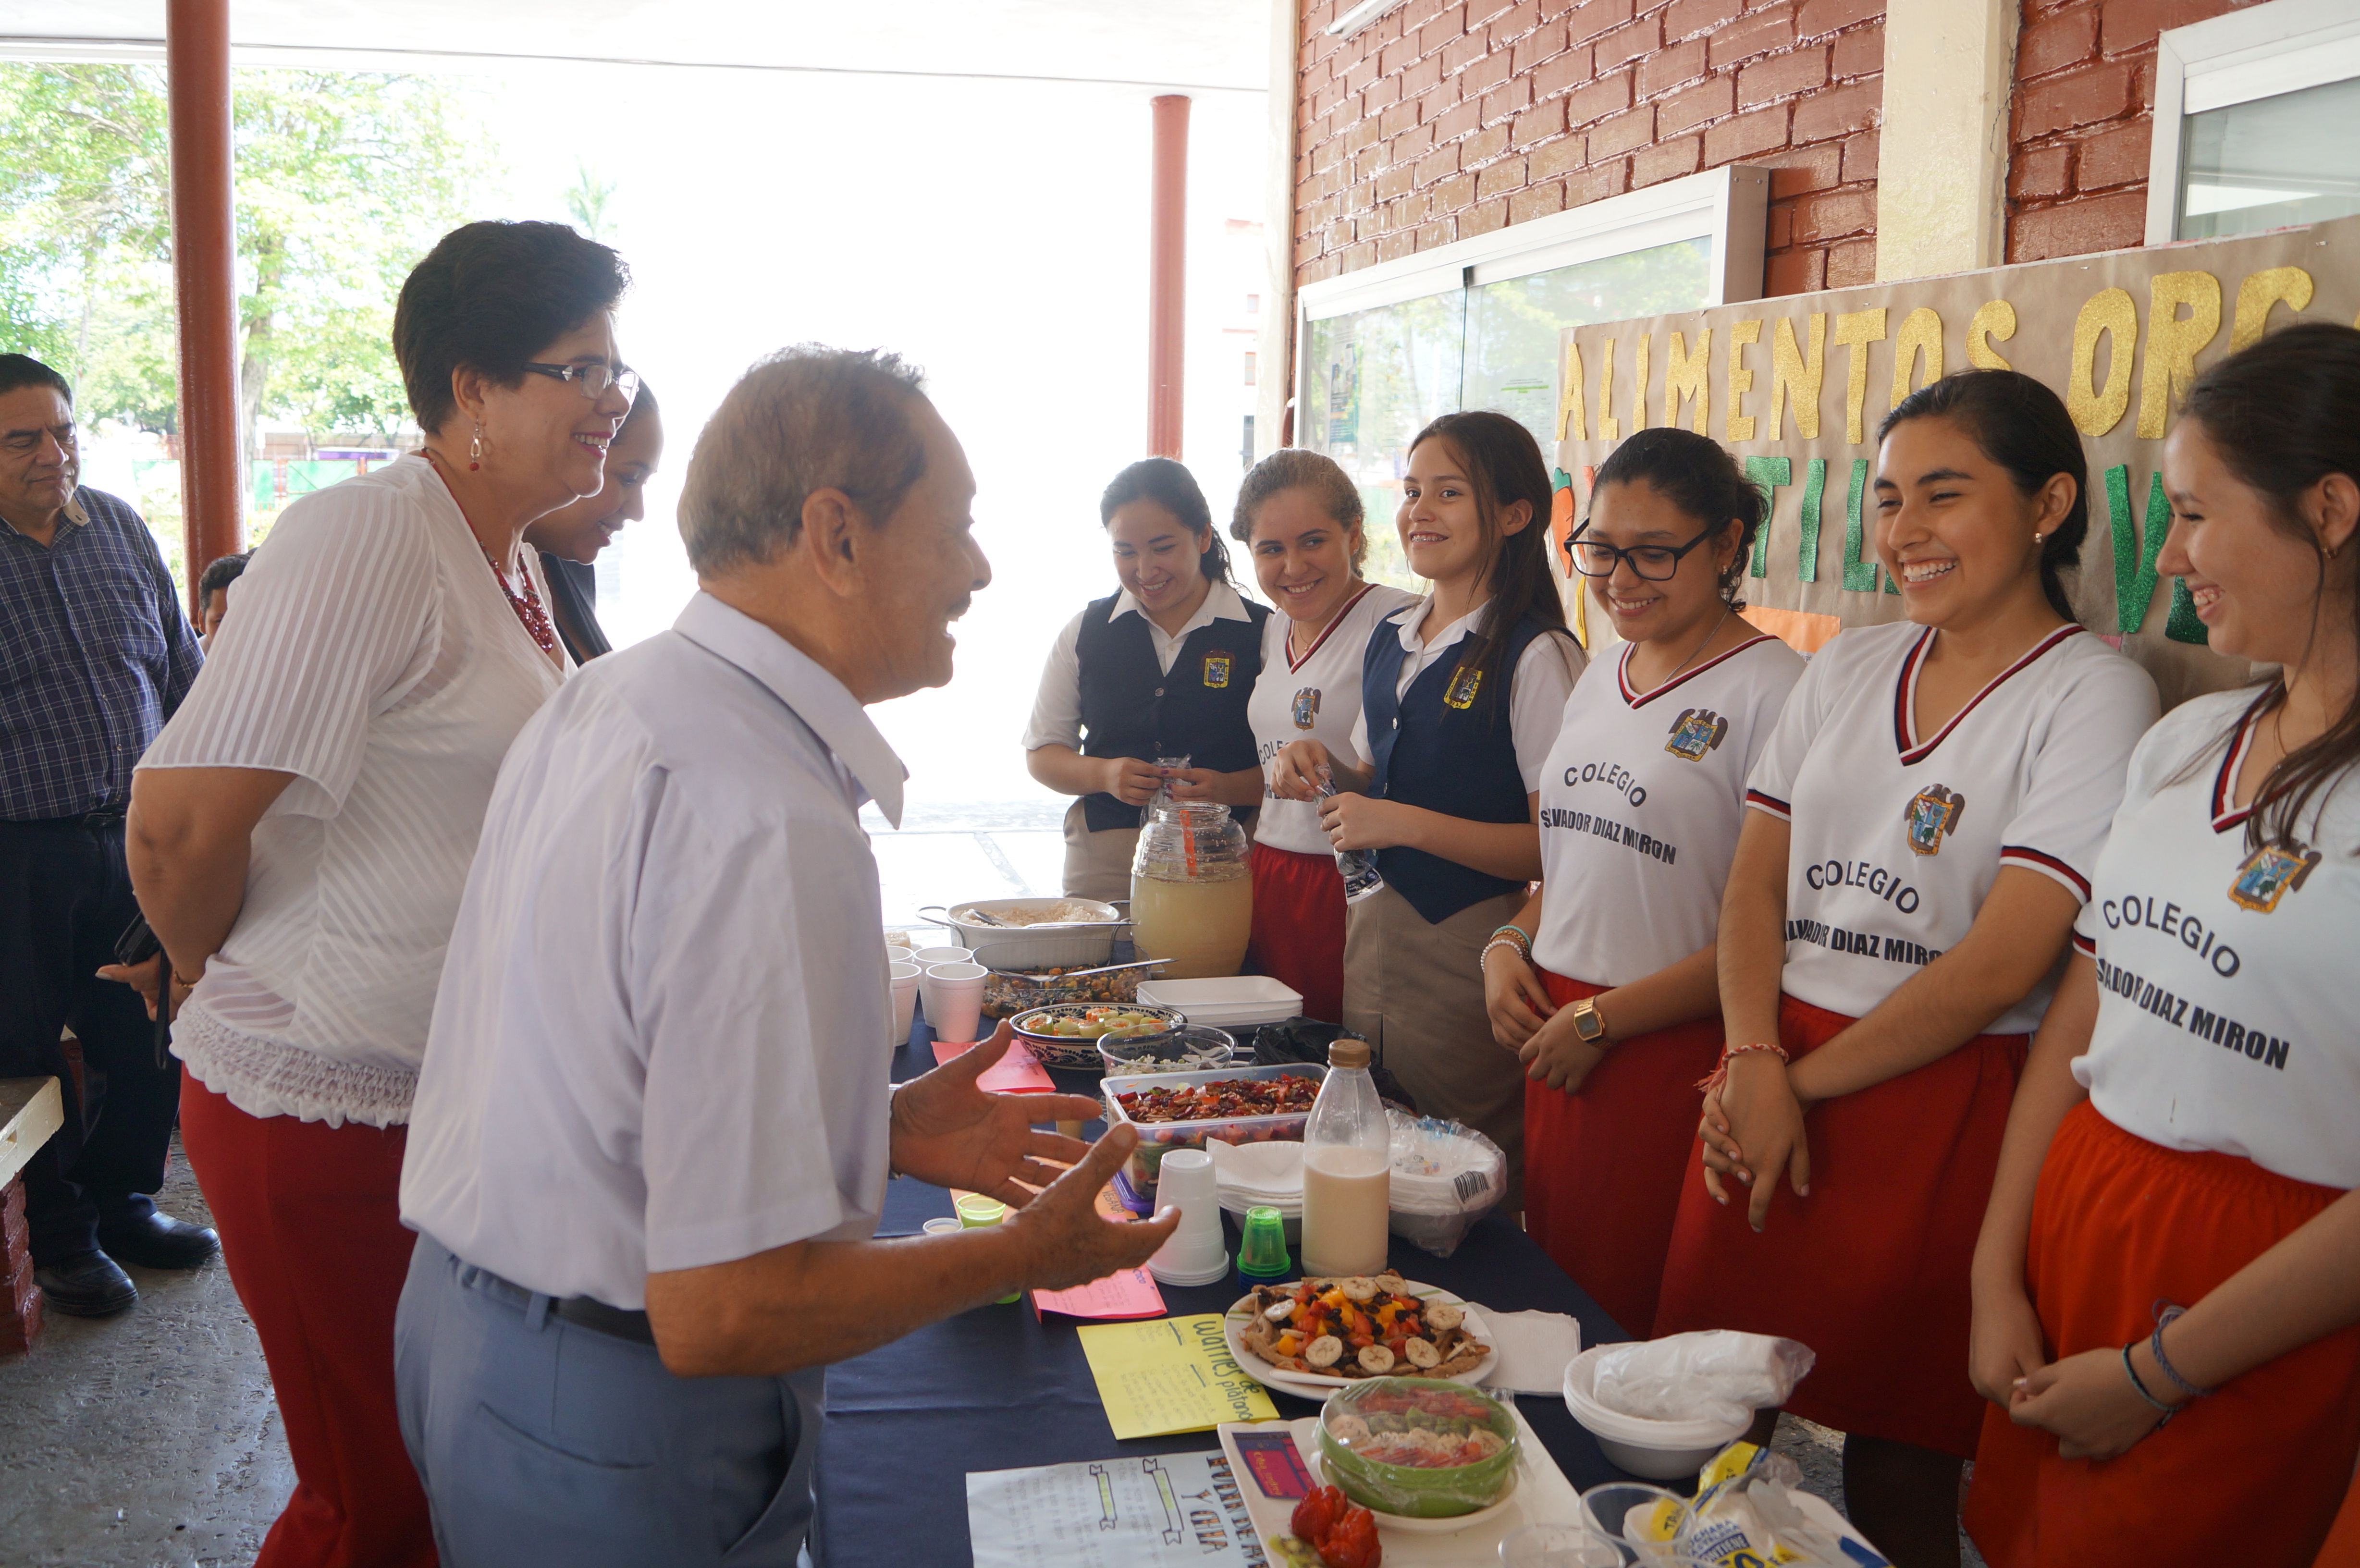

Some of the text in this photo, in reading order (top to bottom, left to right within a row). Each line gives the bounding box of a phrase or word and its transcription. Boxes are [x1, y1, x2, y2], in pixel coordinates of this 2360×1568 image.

[1555, 299, 2016, 444] ALIMENTOS
[1449, 700, 1463, 708] DIAZ
[1259, 740, 1290, 765] COLE
[1564, 762, 1647, 807] COLEGIO
[1592, 816, 1621, 843] DIAZ
[1622, 828, 1677, 865] MIRON
[1807, 860, 1919, 914] COLEGIO
[1831, 927, 1880, 958] DIAZ
[1884, 938, 1944, 966] MIRO
[2102, 895, 2240, 978] COLEGIO
[2139, 982, 2189, 1028] DIAZ
[2189, 1005, 2290, 1071] MIRON
[1180, 1488, 1214, 1505] Y
